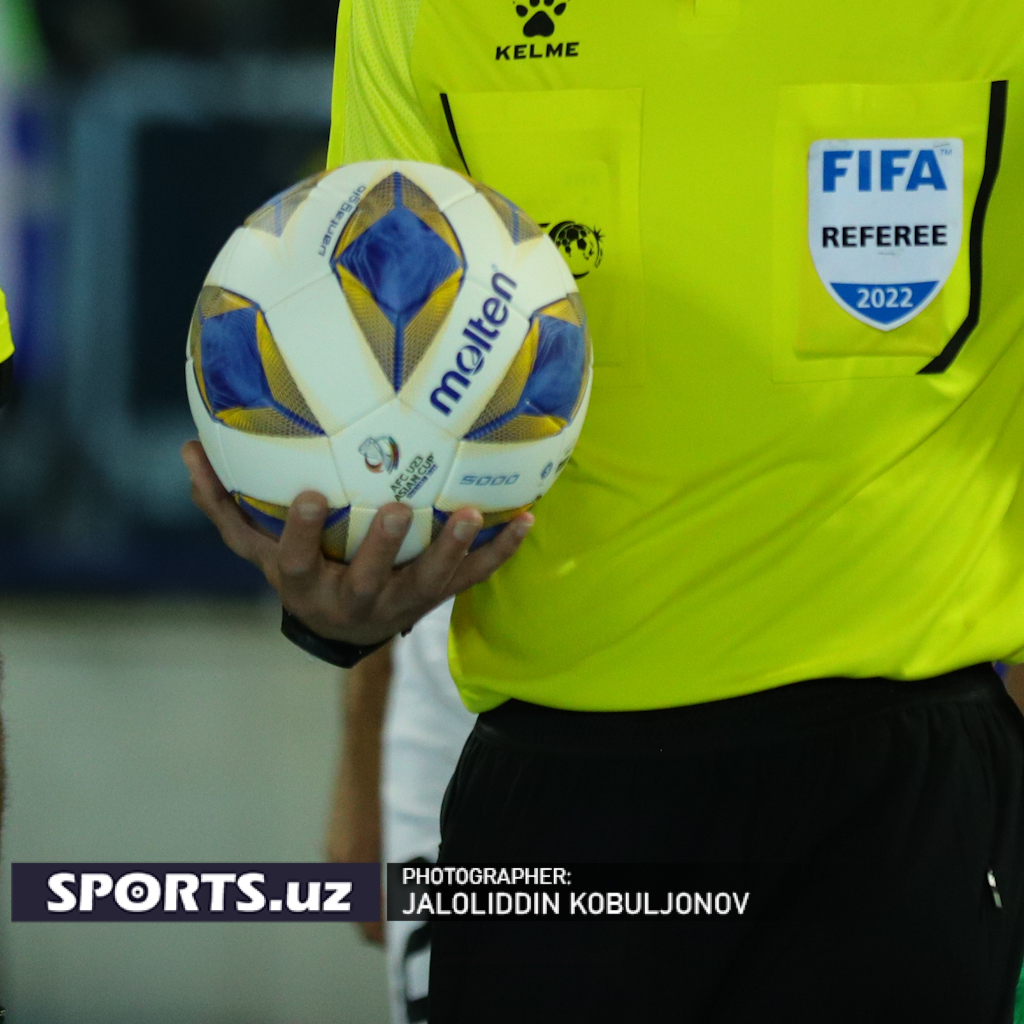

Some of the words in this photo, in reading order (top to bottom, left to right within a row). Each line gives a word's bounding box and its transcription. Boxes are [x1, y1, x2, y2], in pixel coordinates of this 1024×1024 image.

[495, 41, 580, 60] KELME
[822, 149, 948, 192] FIFA
[317, 185, 367, 257] vantaggio
[822, 225, 948, 248] REFEREE
[856, 288, 914, 308] 2022
[429, 270, 518, 417] molten
[390, 473, 409, 492] AFC
[405, 455, 424, 474] U23
[394, 474, 421, 502] ASIAN
[417, 454, 434, 475] CUP
[460, 474, 520, 486] 5000
